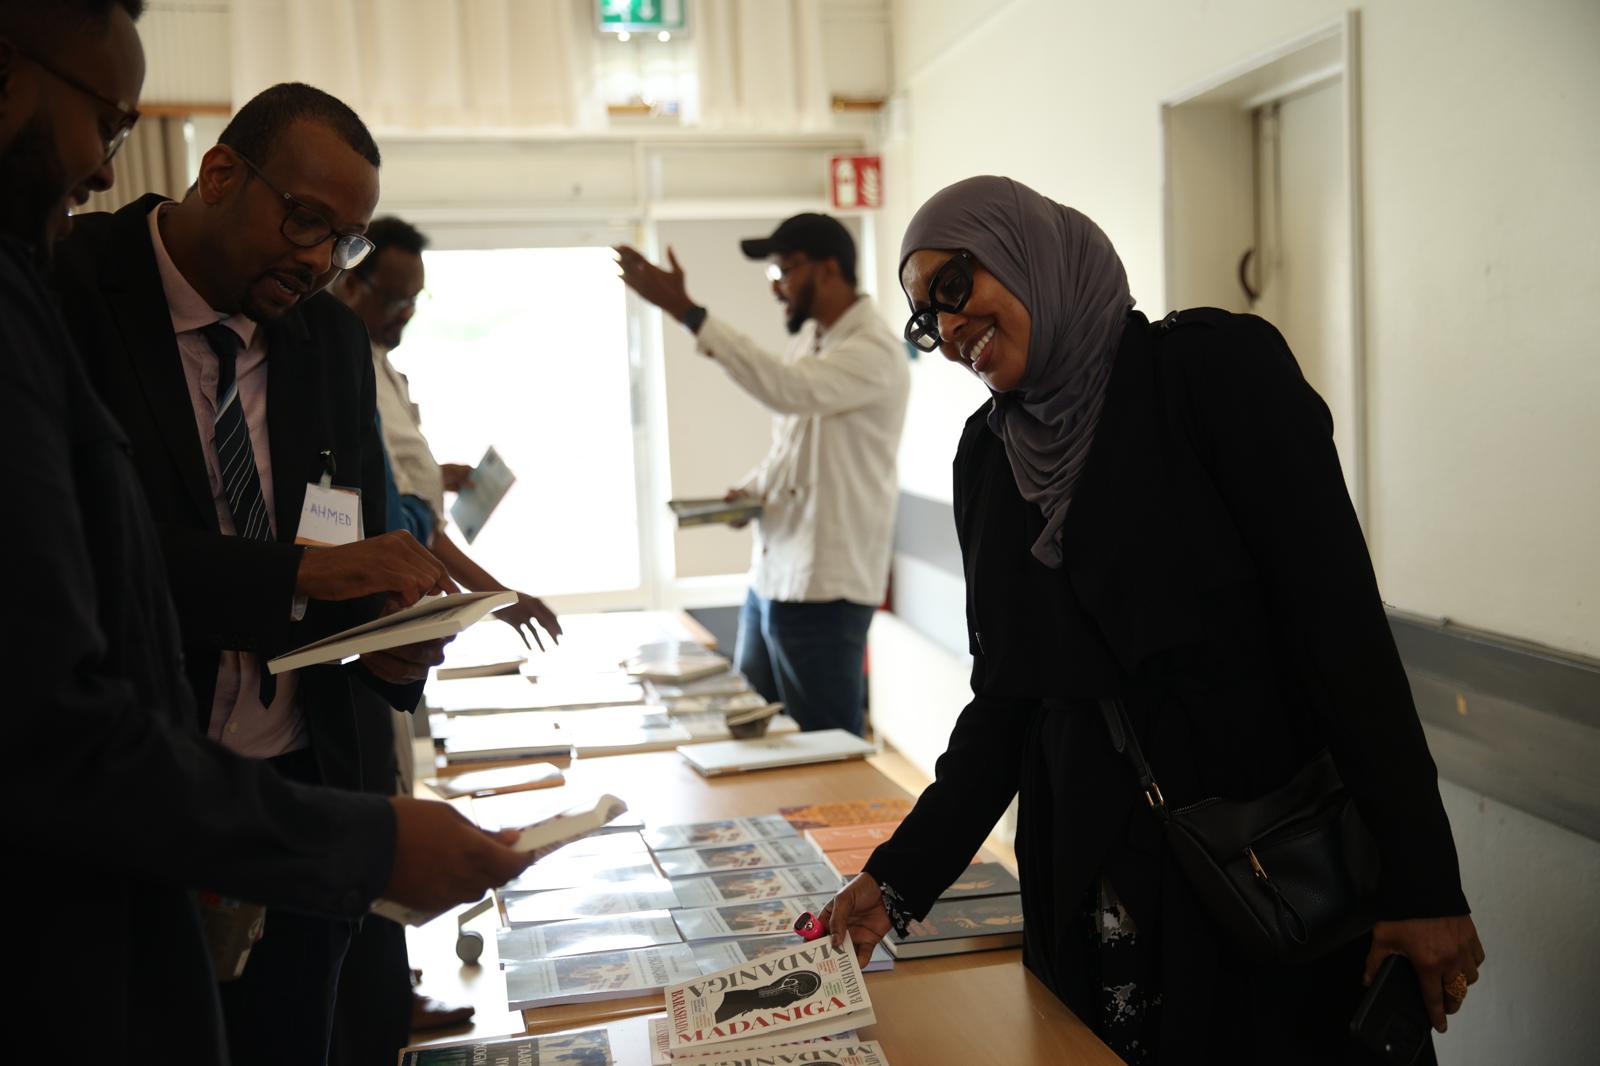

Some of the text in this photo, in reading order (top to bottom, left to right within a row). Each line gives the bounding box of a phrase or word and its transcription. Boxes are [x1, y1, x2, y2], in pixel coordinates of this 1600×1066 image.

[310, 503, 352, 526] AHMED
[687, 944, 847, 998] MADANIGA
[836, 953, 863, 1005] BARASHADA
[671, 989, 688, 1034] BARASHADA
[678, 996, 847, 1043] MADANIGA
[697, 1045, 873, 1066] MADANIG
